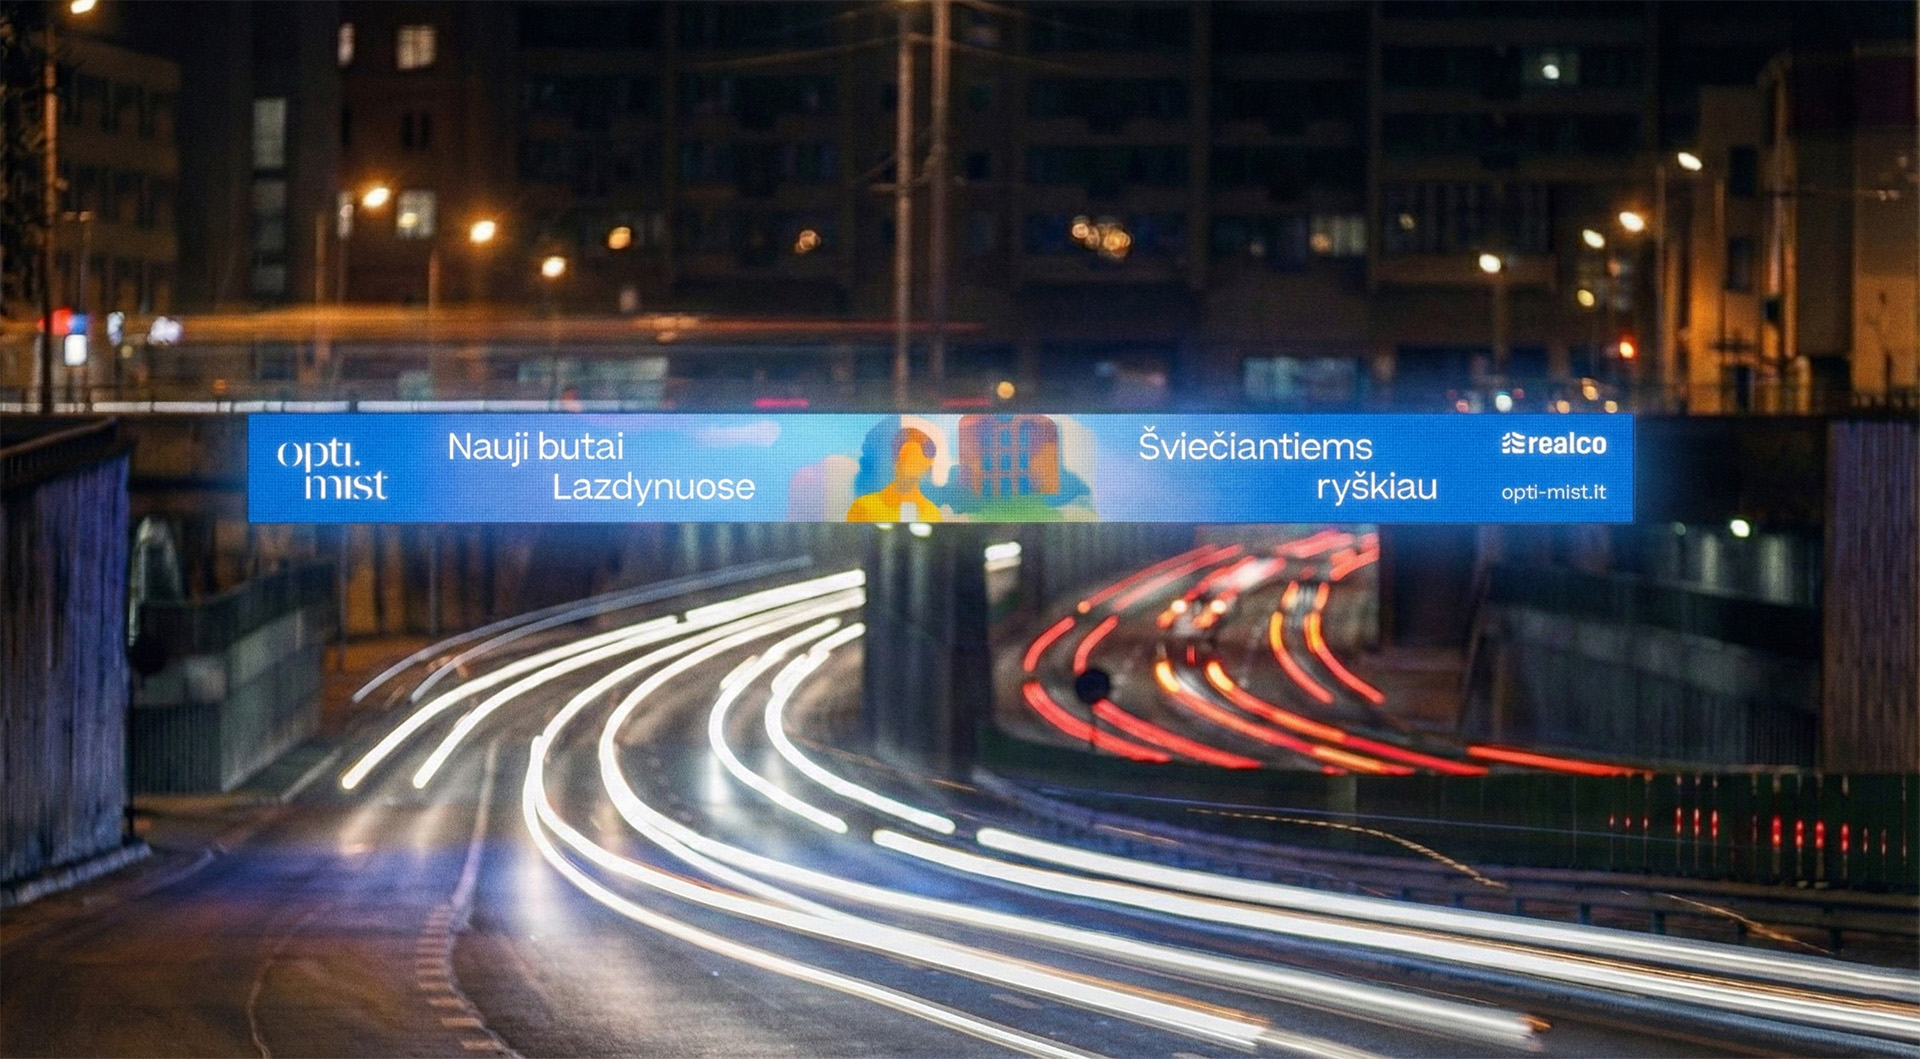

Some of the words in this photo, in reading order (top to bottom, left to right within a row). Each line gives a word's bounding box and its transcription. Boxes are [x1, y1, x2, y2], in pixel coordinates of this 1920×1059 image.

[448, 431, 529, 468] Nauji
[538, 431, 624, 460] butai
[1139, 425, 1374, 461] Šviečiantiems
[1527, 431, 1608, 455] realco
[304, 470, 389, 500] mist
[553, 471, 756, 507] Lazdynuose
[1317, 470, 1438, 507] ryškiau
